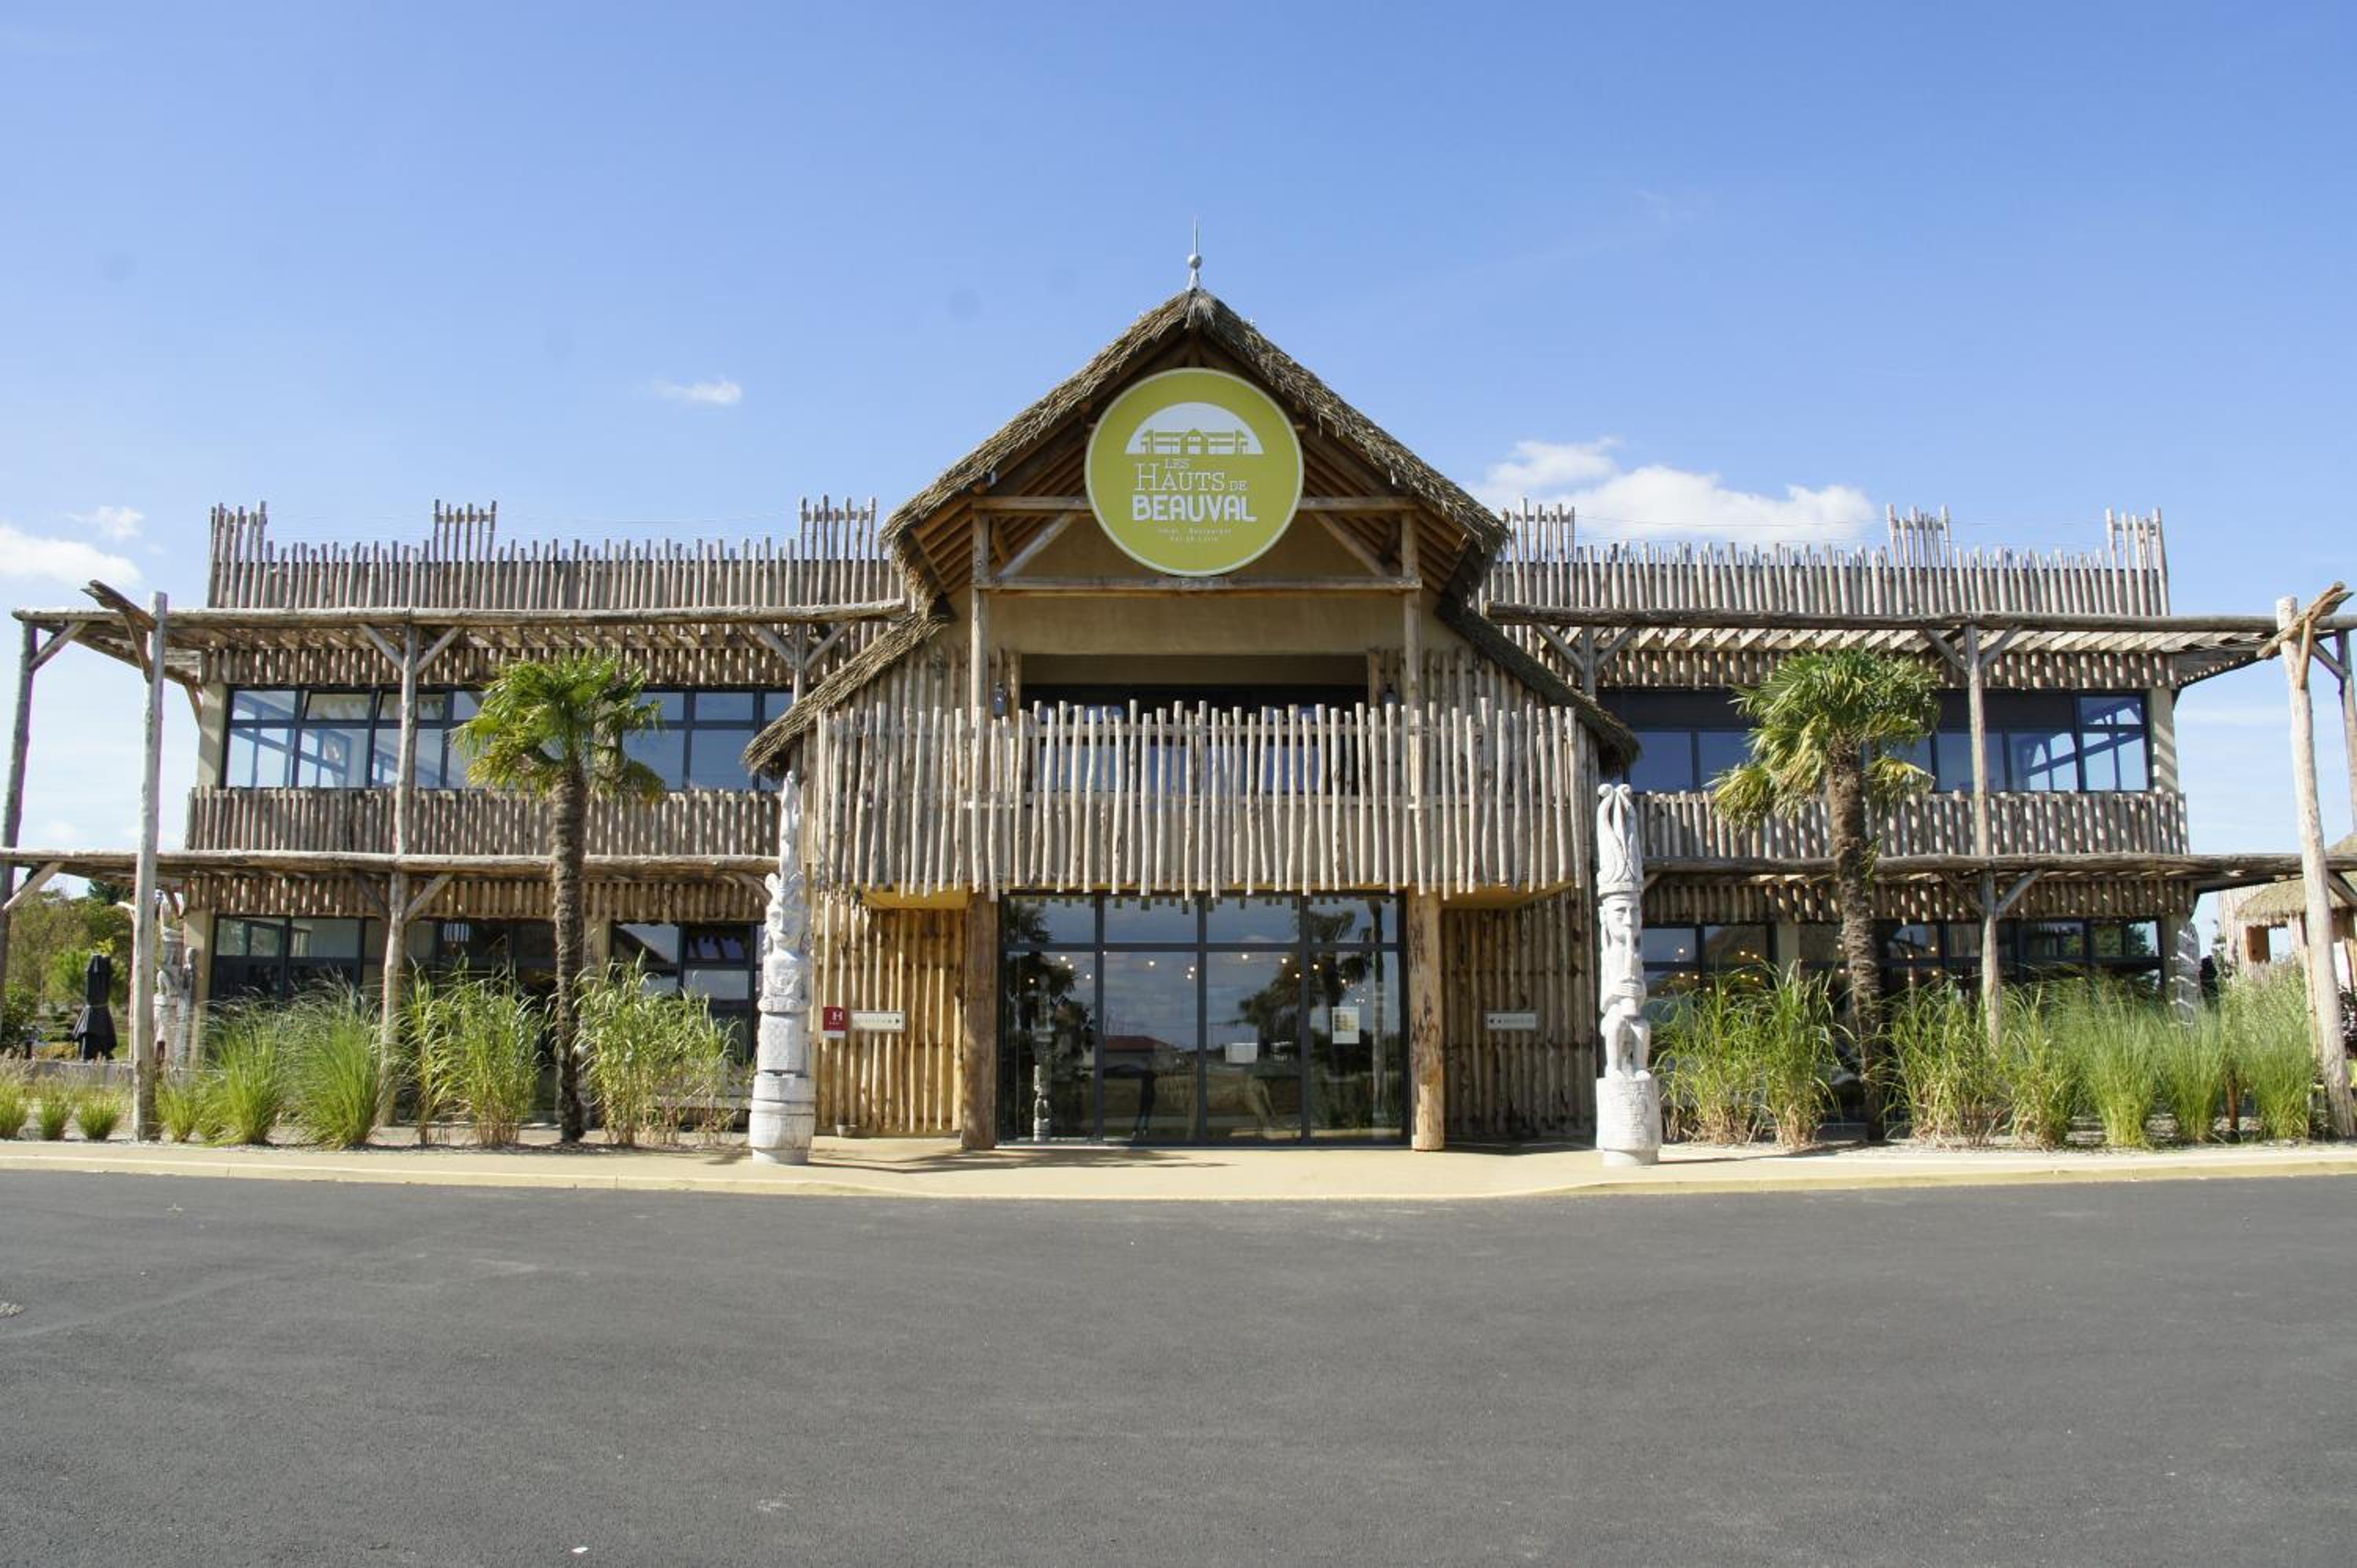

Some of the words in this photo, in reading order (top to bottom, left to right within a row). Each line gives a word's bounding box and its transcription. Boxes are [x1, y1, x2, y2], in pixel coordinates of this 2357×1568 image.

[1165, 459, 1189, 469] LES
[1135, 463, 1225, 491] HAUTS
[1230, 480, 1248, 491] DE
[1132, 495, 1257, 522] BEAUVAL
[833, 1011, 843, 1020] H
